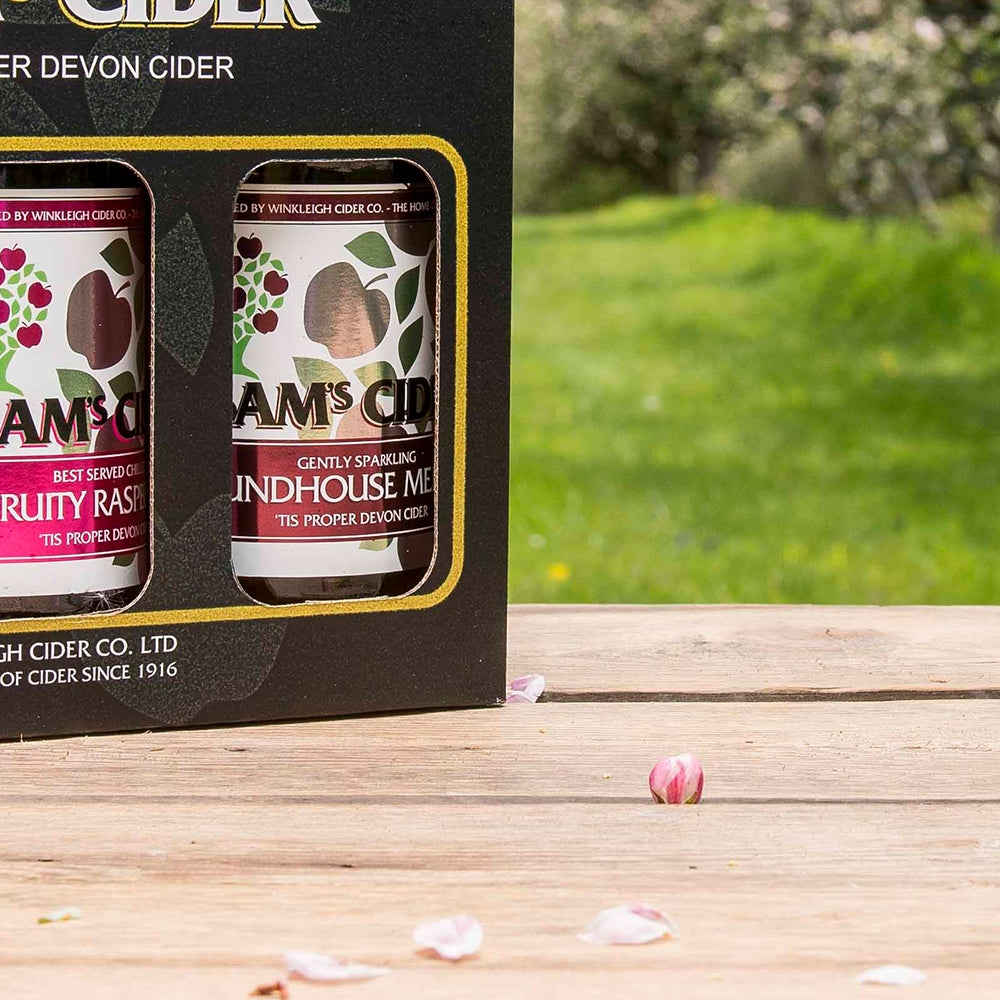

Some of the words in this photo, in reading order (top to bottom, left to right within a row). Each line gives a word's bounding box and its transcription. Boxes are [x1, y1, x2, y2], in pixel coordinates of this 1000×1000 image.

[42, 55, 140, 79] DEVON
[150, 55, 234, 79] CIDER
[14, 211, 30, 221] BY
[31, 210, 90, 221] WINKLEIGH
[92, 210, 115, 220] CIDER
[251, 204, 265, 213] BY
[267, 203, 332, 214] WINKLEIGH
[335, 203, 365, 214] CIDER
[367, 203, 384, 214] CO.
[392, 202, 408, 213] THE
[297, 456, 352, 470] GENTLY
[355, 451, 417, 468] SPARKLING
[53, 469, 83, 484] BEST
[86, 466, 125, 482] SERVED
[303, 513, 357, 527] PROPER
[360, 510, 401, 525] DEVON
[403, 505, 429, 521] CIDER
[66, 530, 111, 546] PROPER
[29, 640, 92, 661] CIDER
[96, 637, 133, 656] CO.
[141, 635, 178, 654] LTD
[0, 671, 24, 687] OF
[27, 668, 79, 686] CIDER
[81, 664, 130, 682] SINCE
[138, 661, 178, 679] 1916
